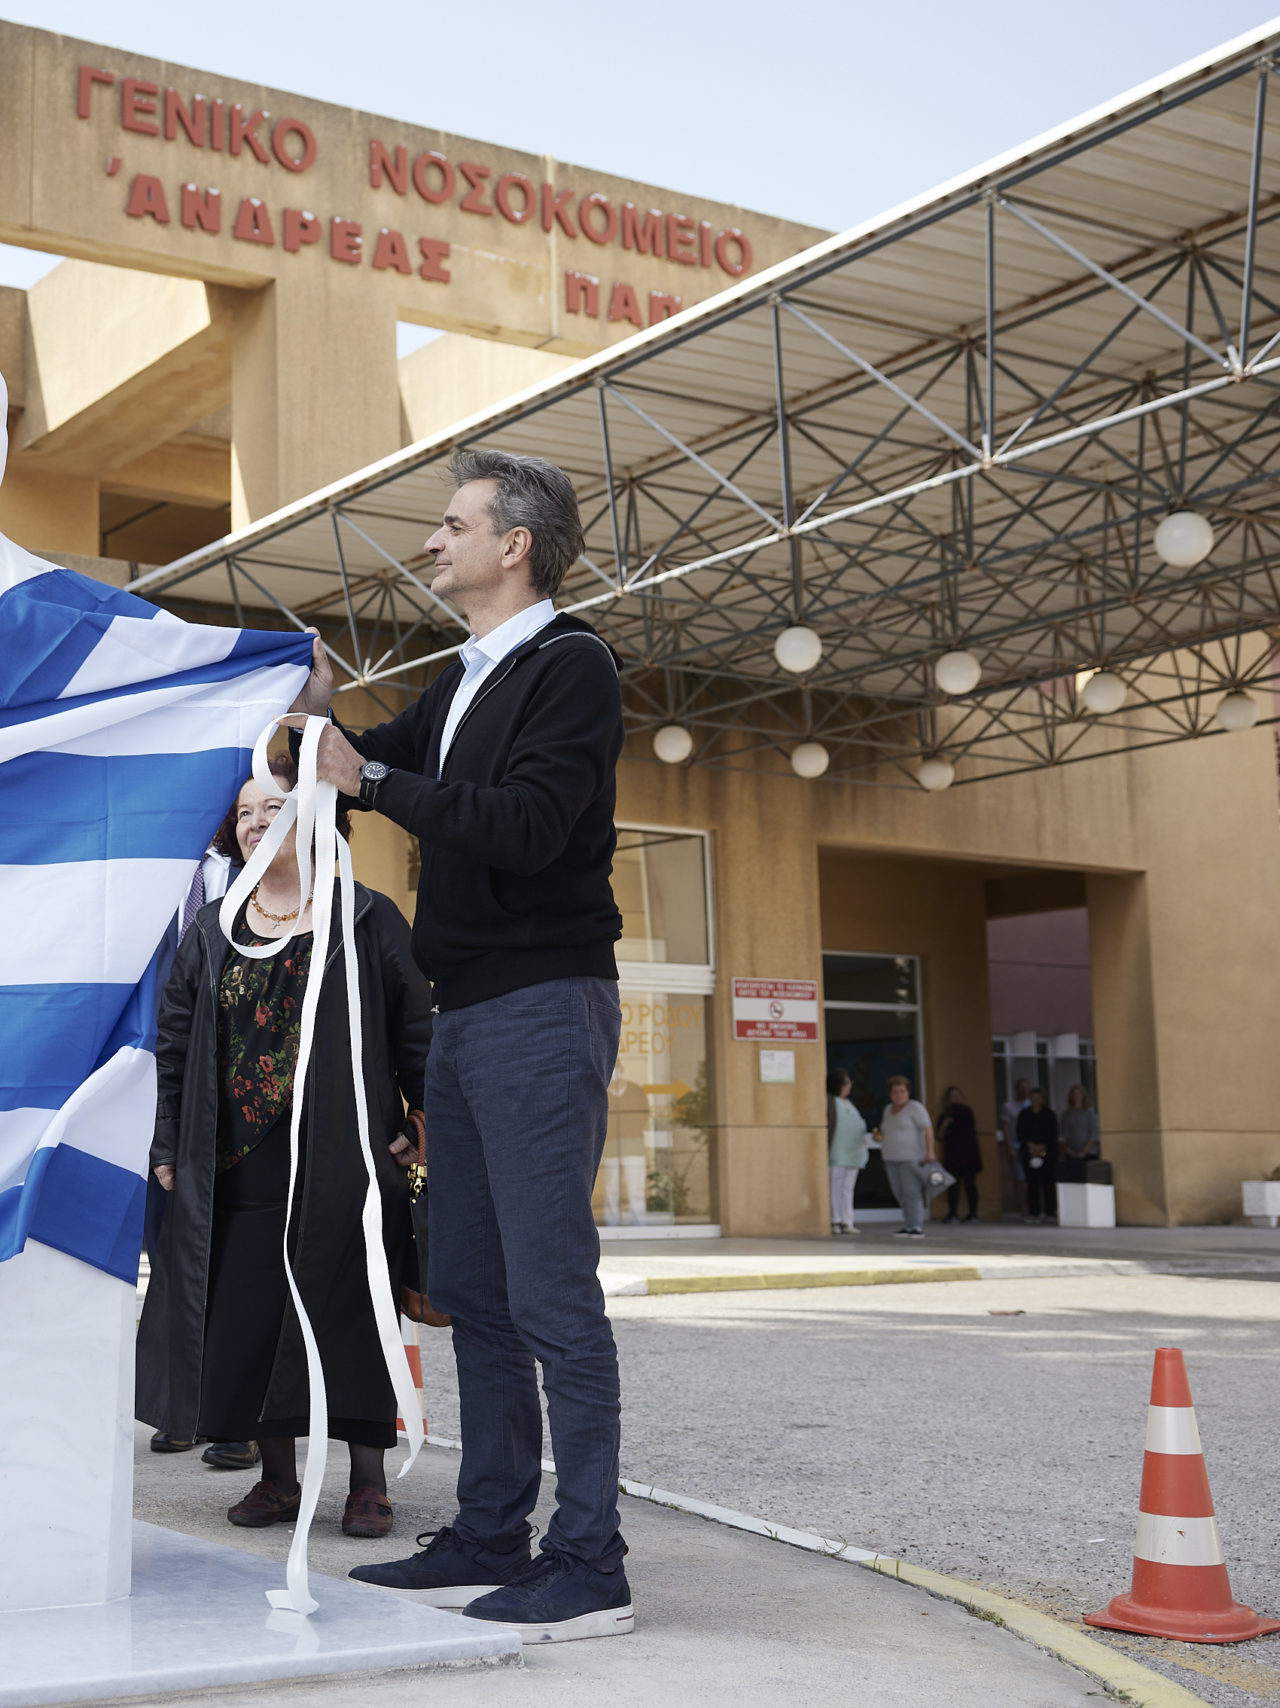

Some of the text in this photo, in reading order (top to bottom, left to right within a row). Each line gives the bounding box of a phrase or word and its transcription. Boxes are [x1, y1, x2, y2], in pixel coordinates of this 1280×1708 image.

[77, 65, 753, 278] ΓΕΝΙΚΟ ΝΟΣΟΚΟΜΕΙΟ
[638, 1003, 704, 1028] ΡΟΔΟΥ
